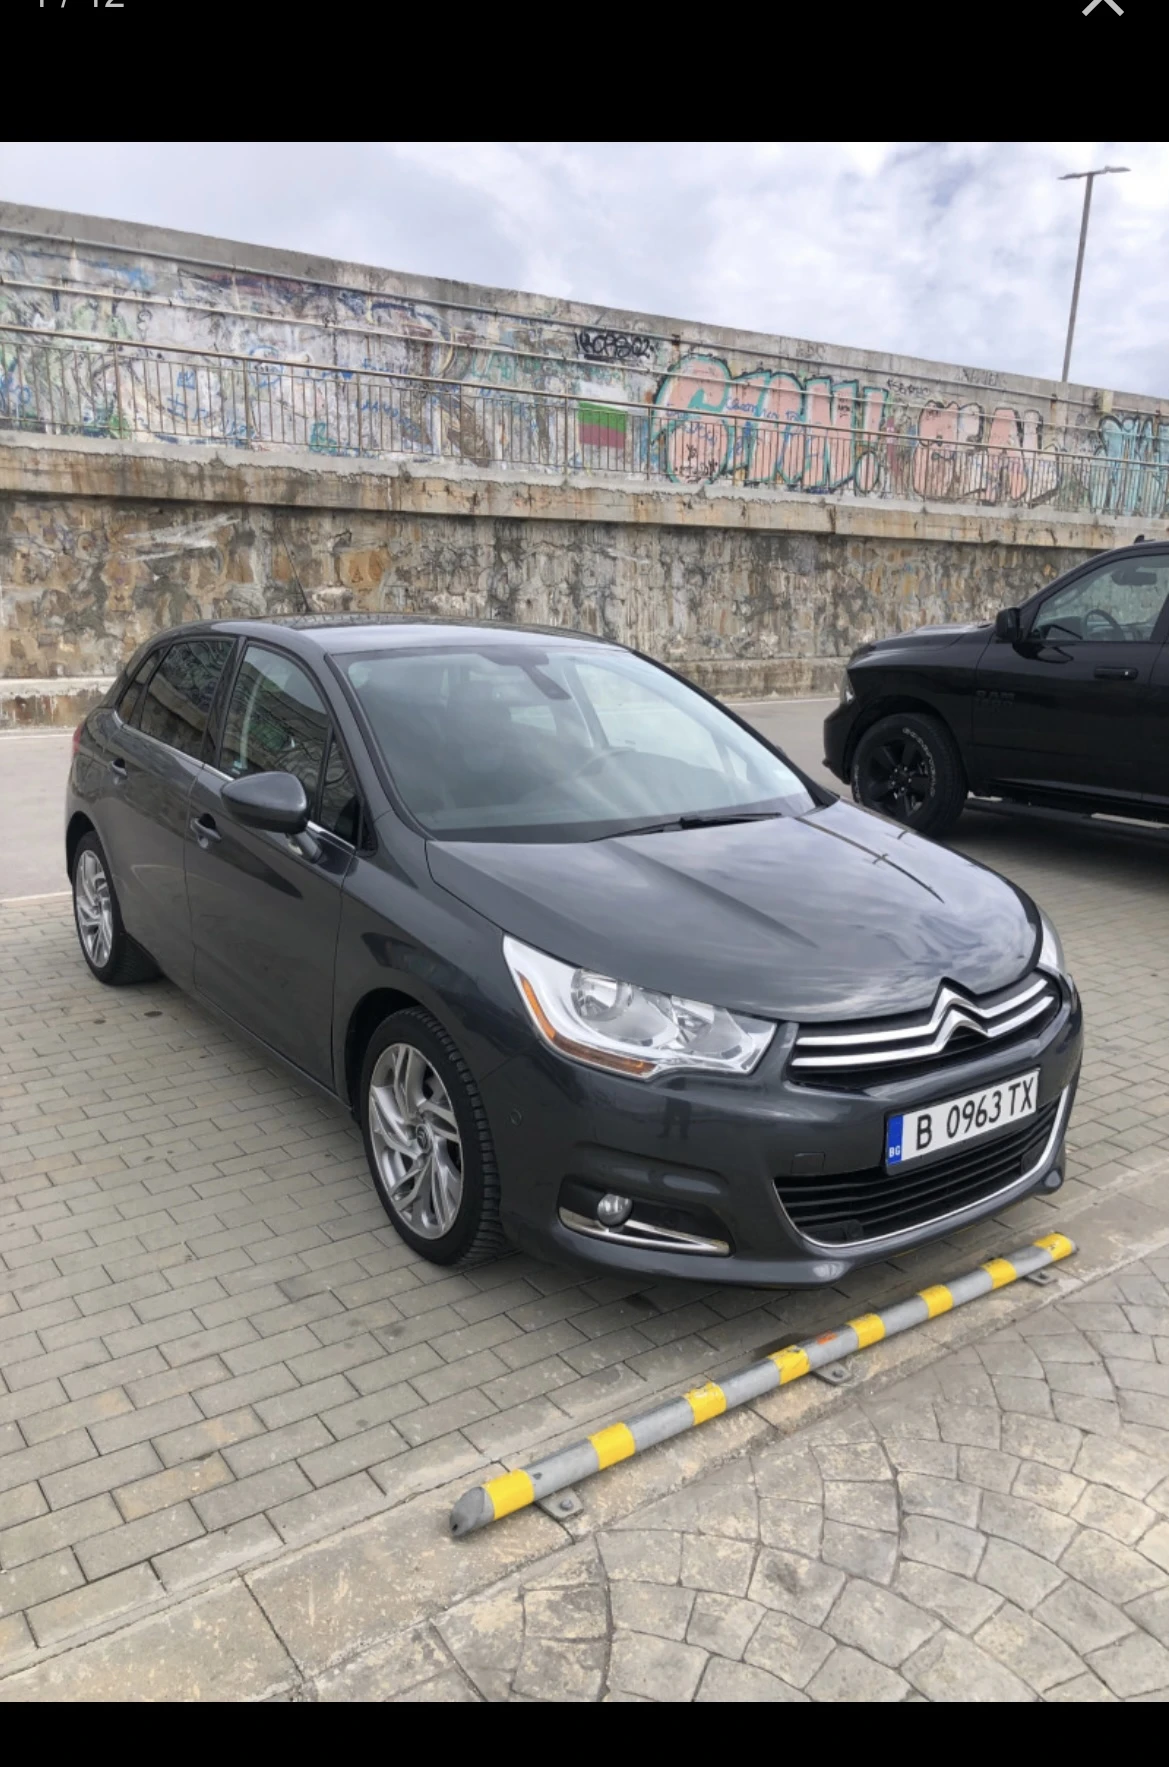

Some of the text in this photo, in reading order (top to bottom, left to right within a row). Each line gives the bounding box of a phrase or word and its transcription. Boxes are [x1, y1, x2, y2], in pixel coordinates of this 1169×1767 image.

[916, 1077, 1034, 1150] B 0963 TX
[889, 1145, 901, 1158] BG
